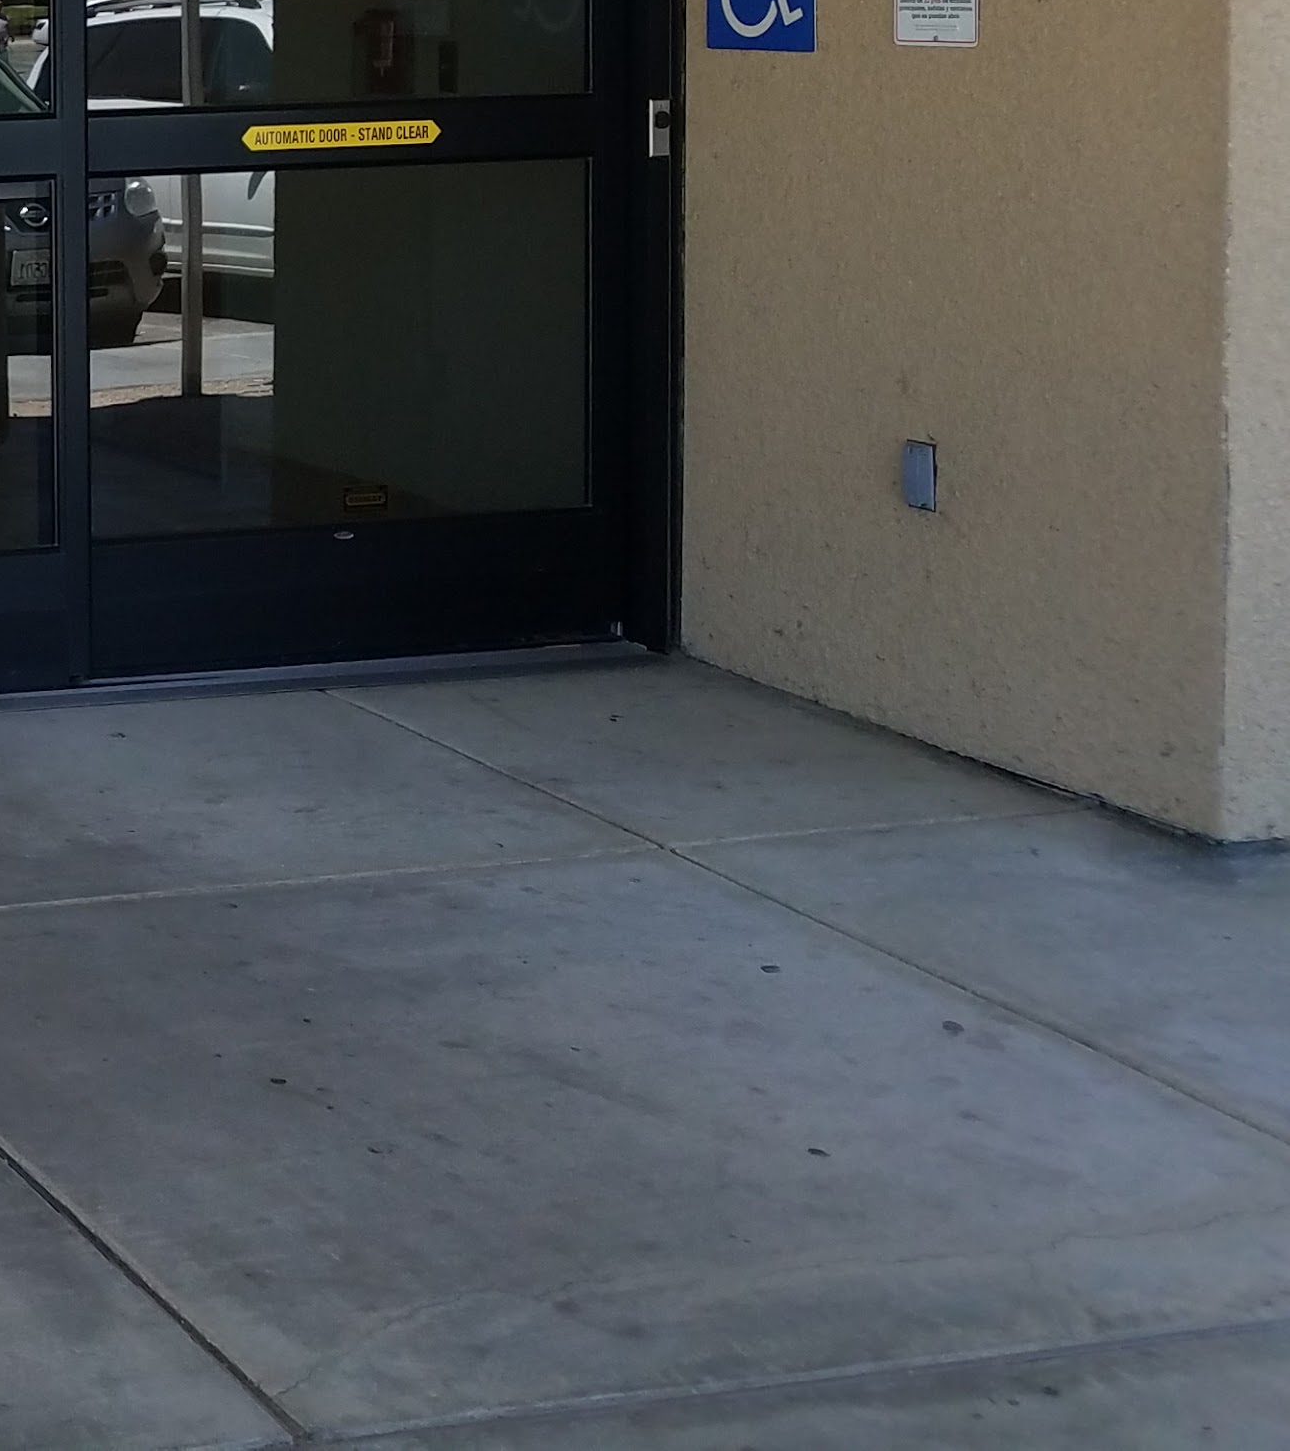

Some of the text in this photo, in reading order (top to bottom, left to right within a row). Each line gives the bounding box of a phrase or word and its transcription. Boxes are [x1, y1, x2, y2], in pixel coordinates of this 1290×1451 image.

[254, 129, 315, 145] AUTOMATIC
[319, 128, 347, 143] DOOR
[358, 127, 393, 141] STAND
[396, 125, 429, 140] CLEAR
